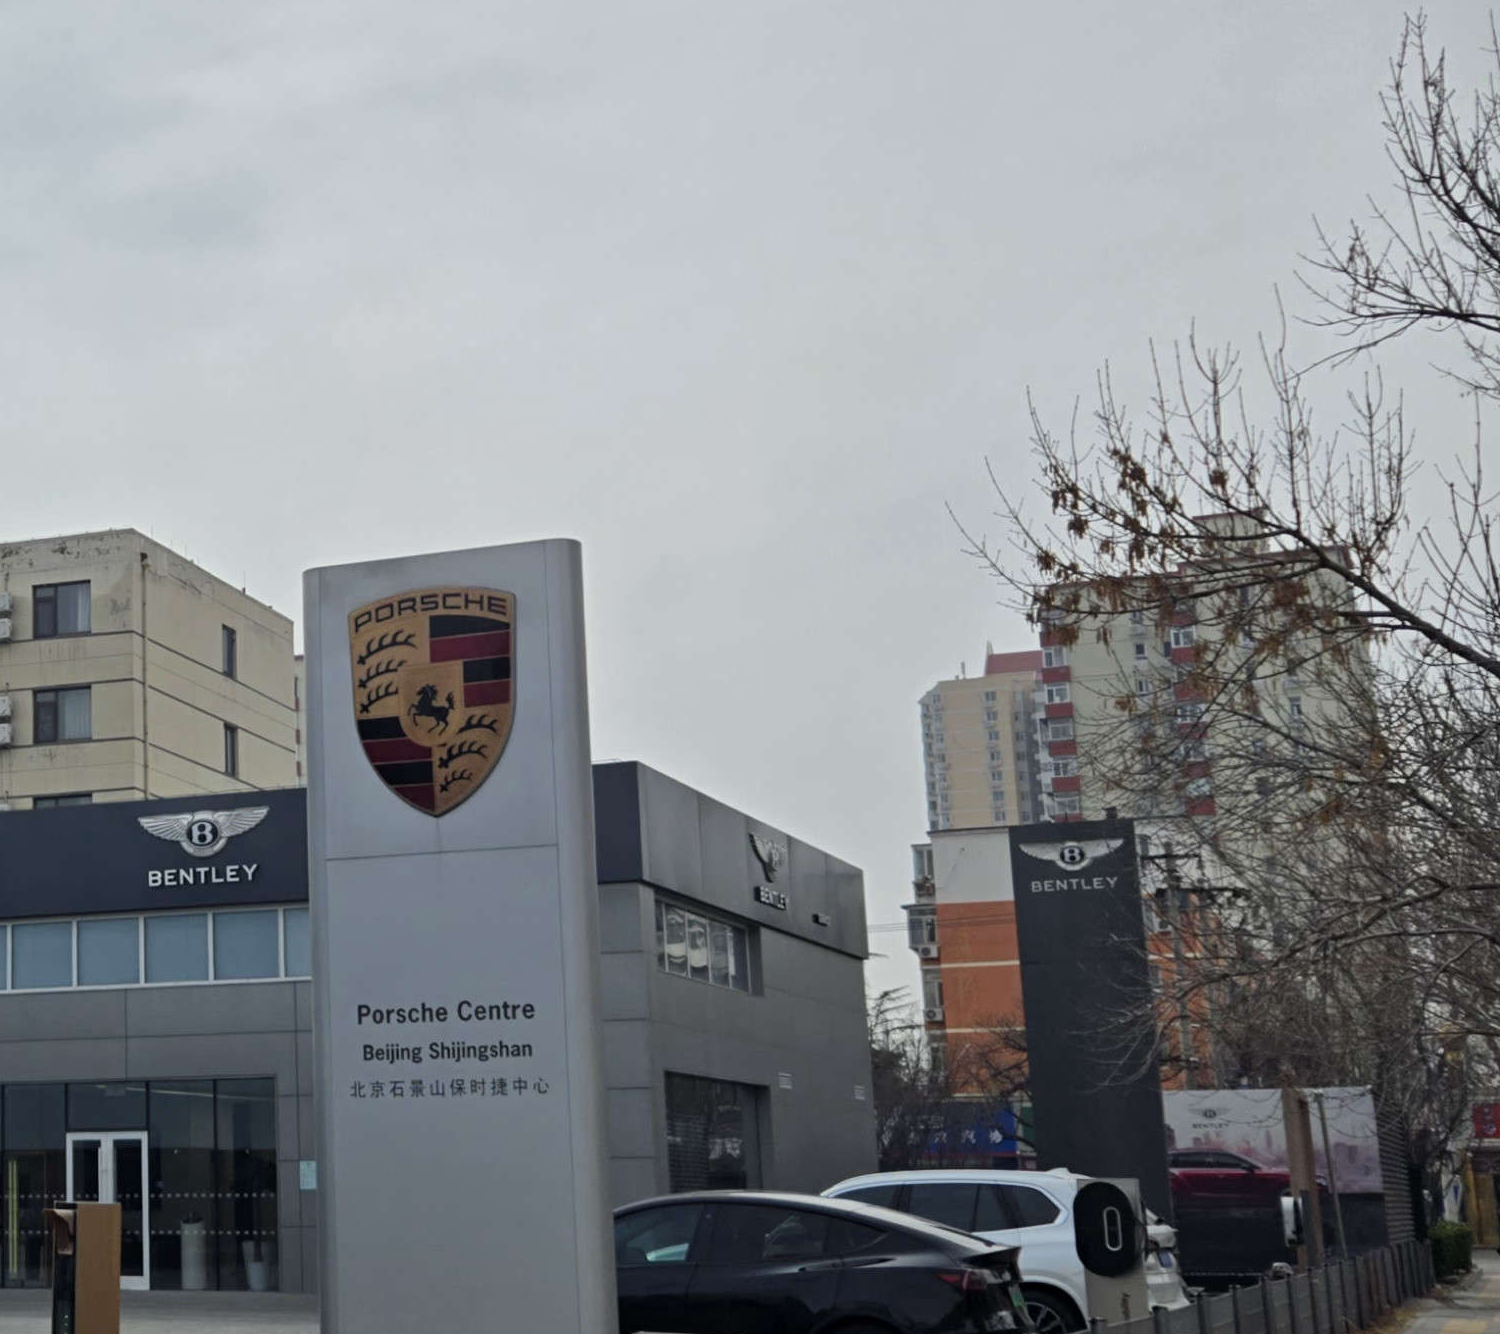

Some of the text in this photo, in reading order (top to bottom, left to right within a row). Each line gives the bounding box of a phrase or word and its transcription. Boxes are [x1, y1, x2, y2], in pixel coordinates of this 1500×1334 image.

[353, 592, 508, 634] PORSCHE
[191, 821, 214, 845] B
[148, 864, 258, 888] BENTLEY
[1030, 877, 1118, 893] BENTLEY
[356, 1000, 536, 1025] Porsche Centre
[362, 1040, 533, 1064] Beijing Shijingshan
[350, 1077, 550, 1099] 北京石景山保时捷中心
